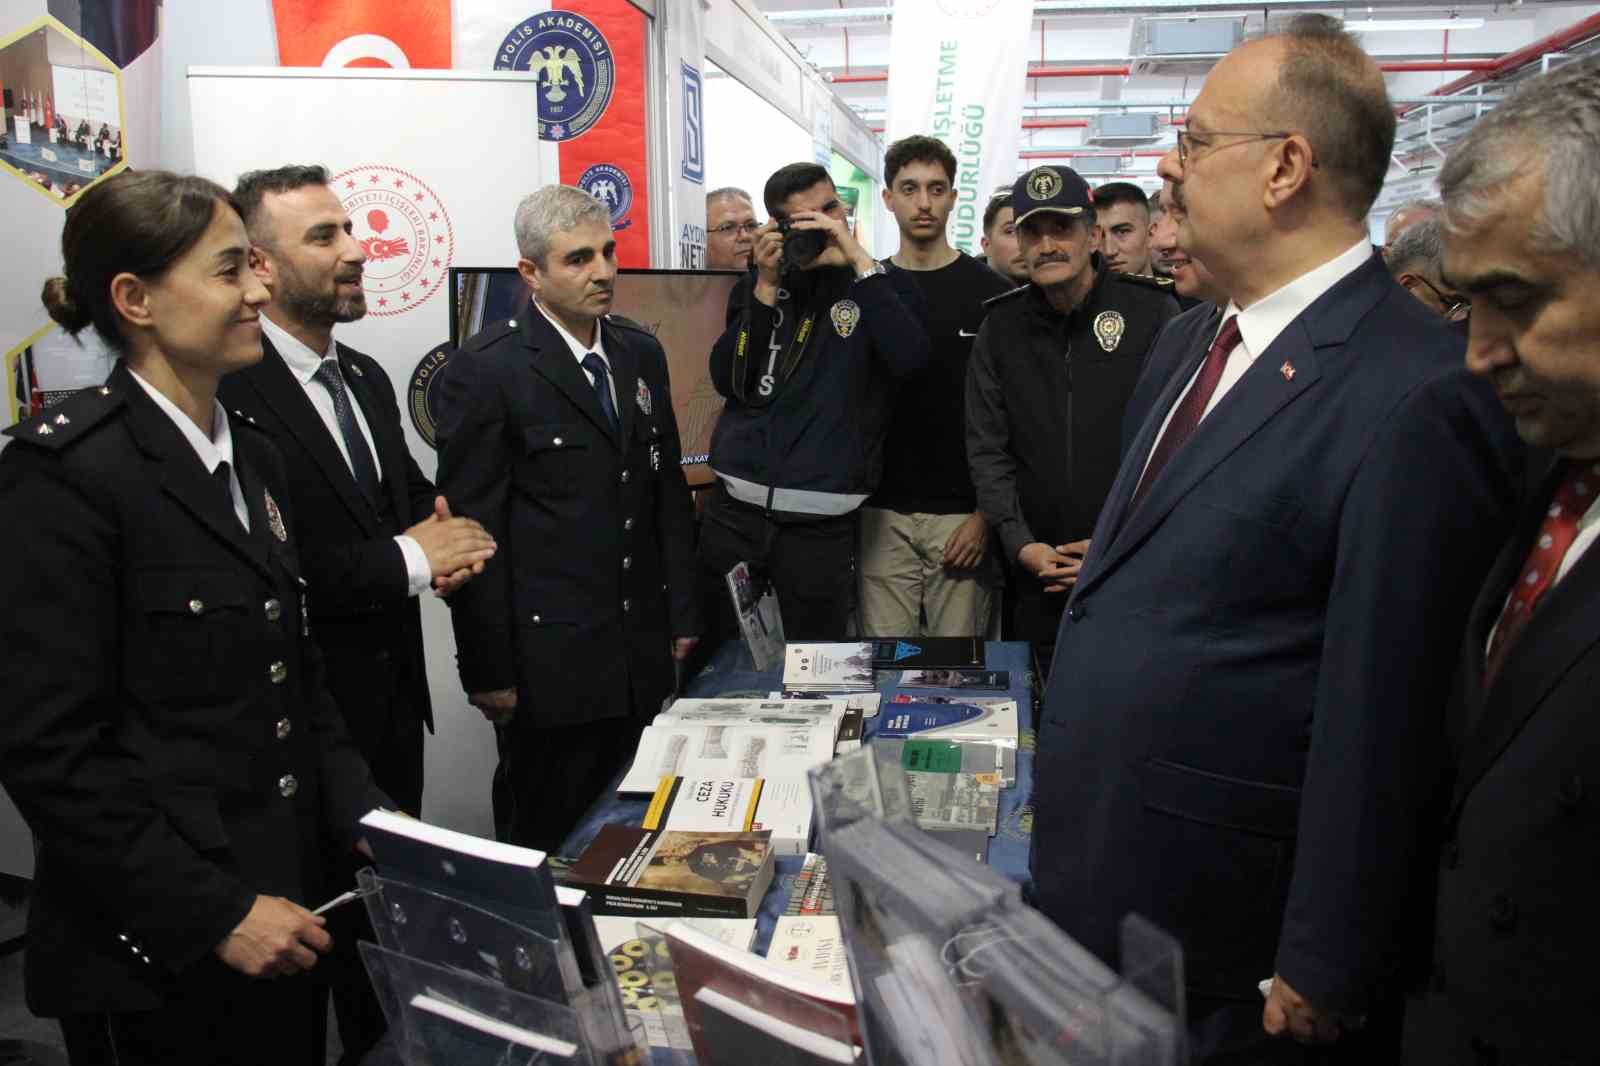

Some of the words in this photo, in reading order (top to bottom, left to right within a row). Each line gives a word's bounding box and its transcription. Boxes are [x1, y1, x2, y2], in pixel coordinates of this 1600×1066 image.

[501, 25, 533, 63] POLİS
[538, 16, 607, 56] AKADEMİSİ
[932, 39, 958, 140] İŞLETME
[696, 780, 714, 803] CEZA
[712, 781, 736, 818] HUKUKU
